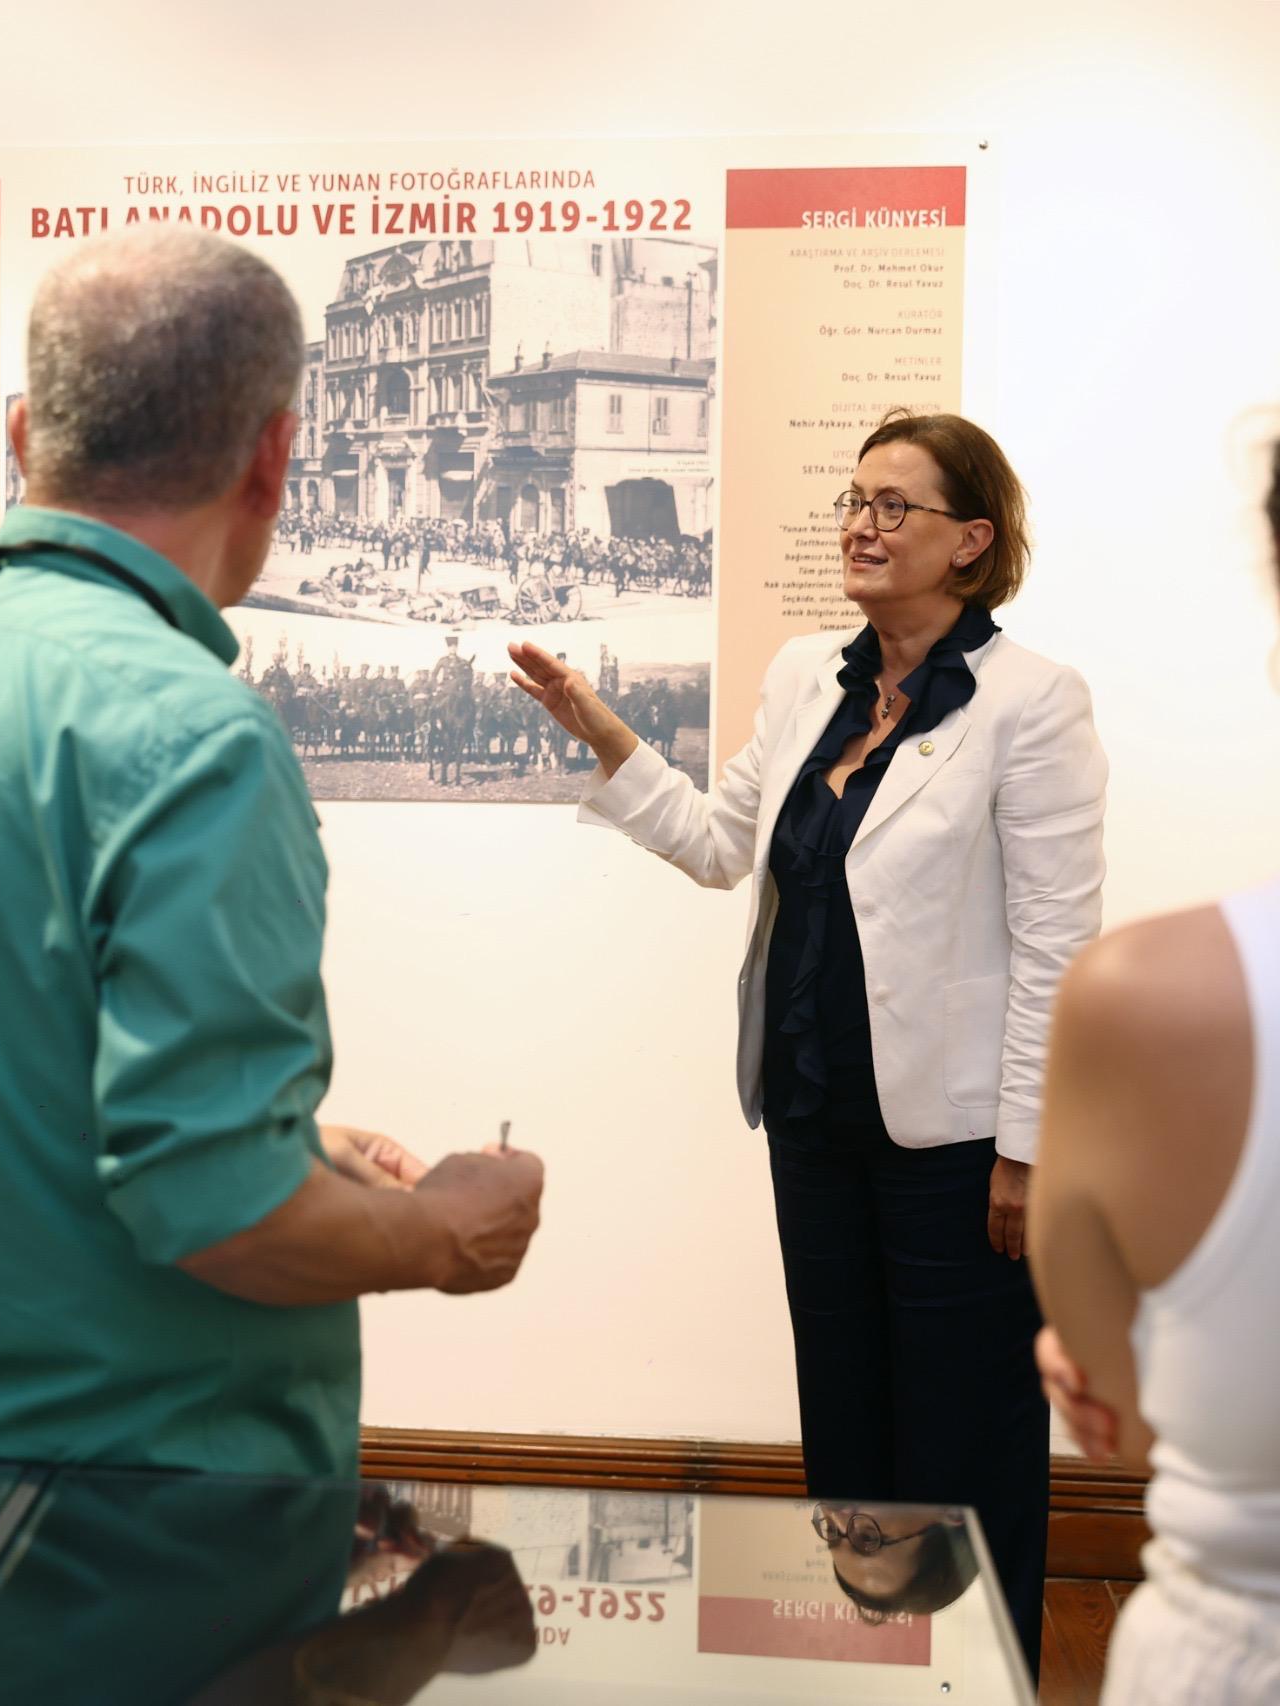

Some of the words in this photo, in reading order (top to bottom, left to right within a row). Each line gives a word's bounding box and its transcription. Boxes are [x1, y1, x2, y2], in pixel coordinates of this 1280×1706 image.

[124, 171, 183, 195] TÜRK,
[193, 169, 269, 193] İNGİLİZ
[277, 173, 300, 192] VE
[309, 172, 380, 191] YUNAN
[390, 168, 595, 190] FOTOĞRAFLARINDA
[32, 207, 107, 238] BATI
[312, 204, 355, 235] VE
[372, 194, 476, 234] İZMİR
[493, 199, 691, 232] 1919-1922
[801, 206, 857, 229] SERGİ
[865, 205, 946, 229] KÜNYESİ
[878, 264, 916, 273] Mehmet
[868, 326, 902, 335] Nurcan
[789, 420, 815, 428] Nehir
[802, 466, 825, 475] SETA
